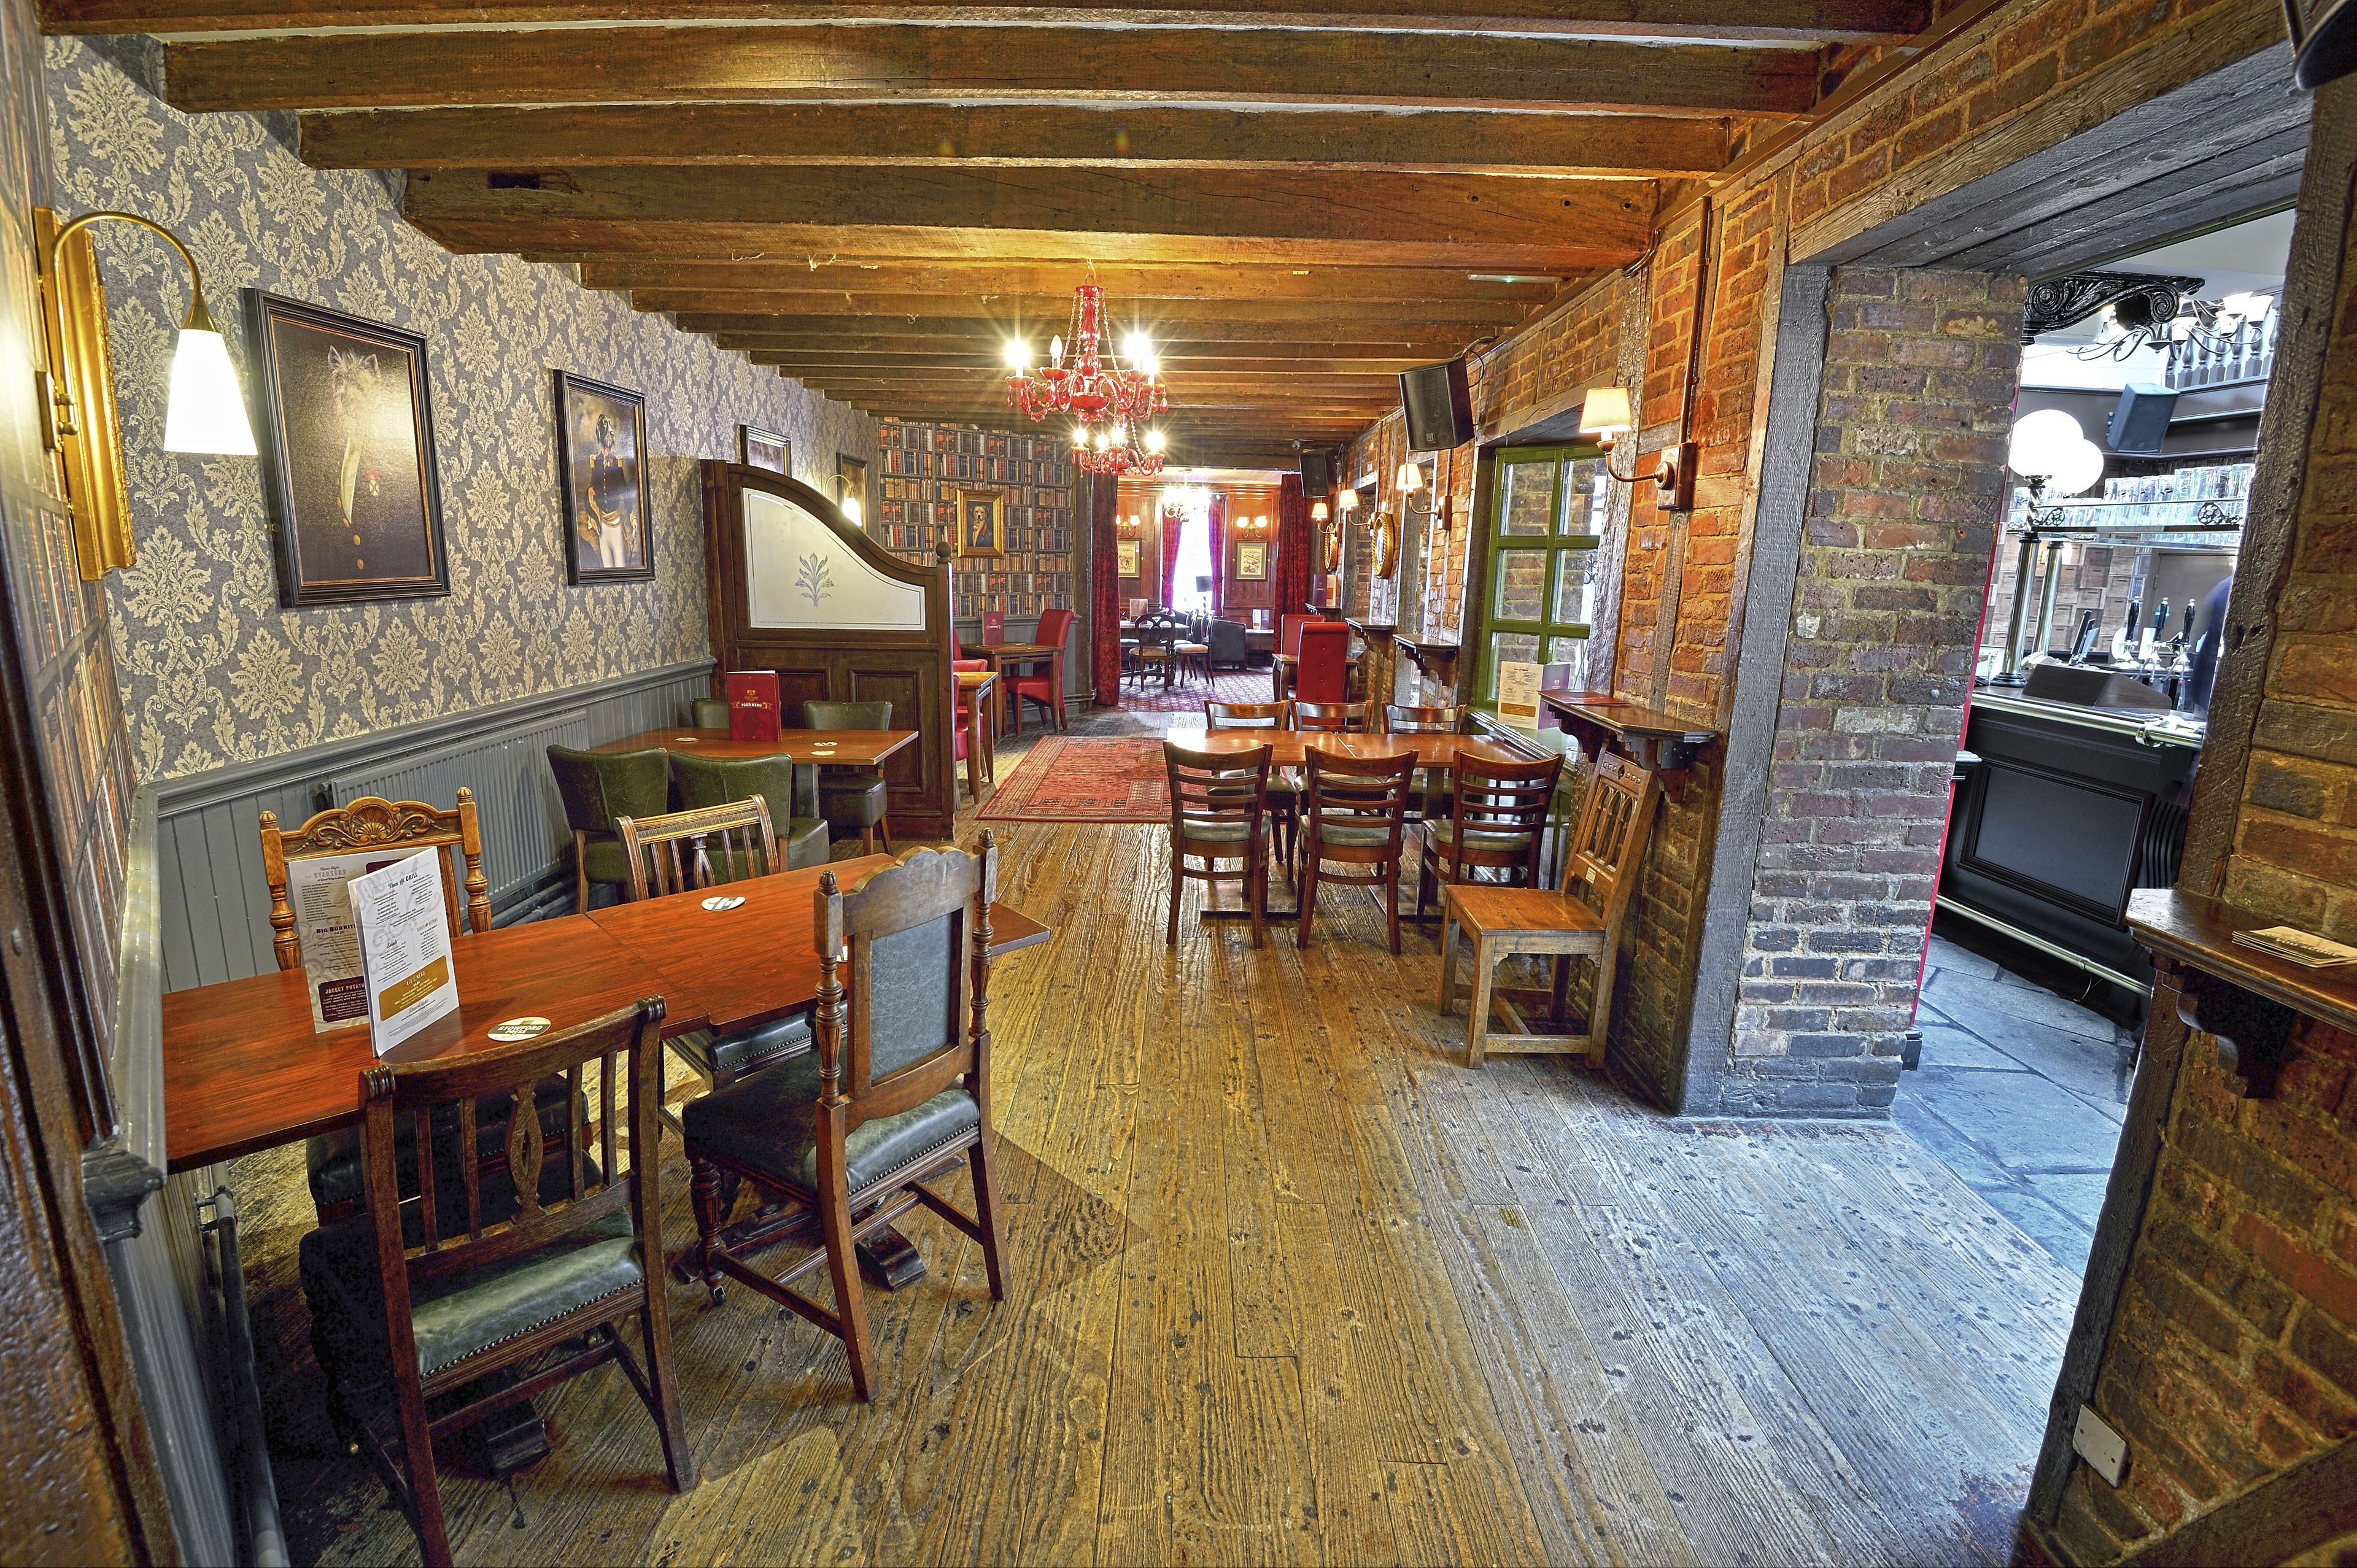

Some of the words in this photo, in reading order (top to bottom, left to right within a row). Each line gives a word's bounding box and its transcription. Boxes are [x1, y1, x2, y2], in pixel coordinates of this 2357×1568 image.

[314, 869, 347, 878] STARTERS
[405, 872, 418, 882] GRILL
[387, 940, 398, 948] Salads
[416, 971, 425, 981] MENU
